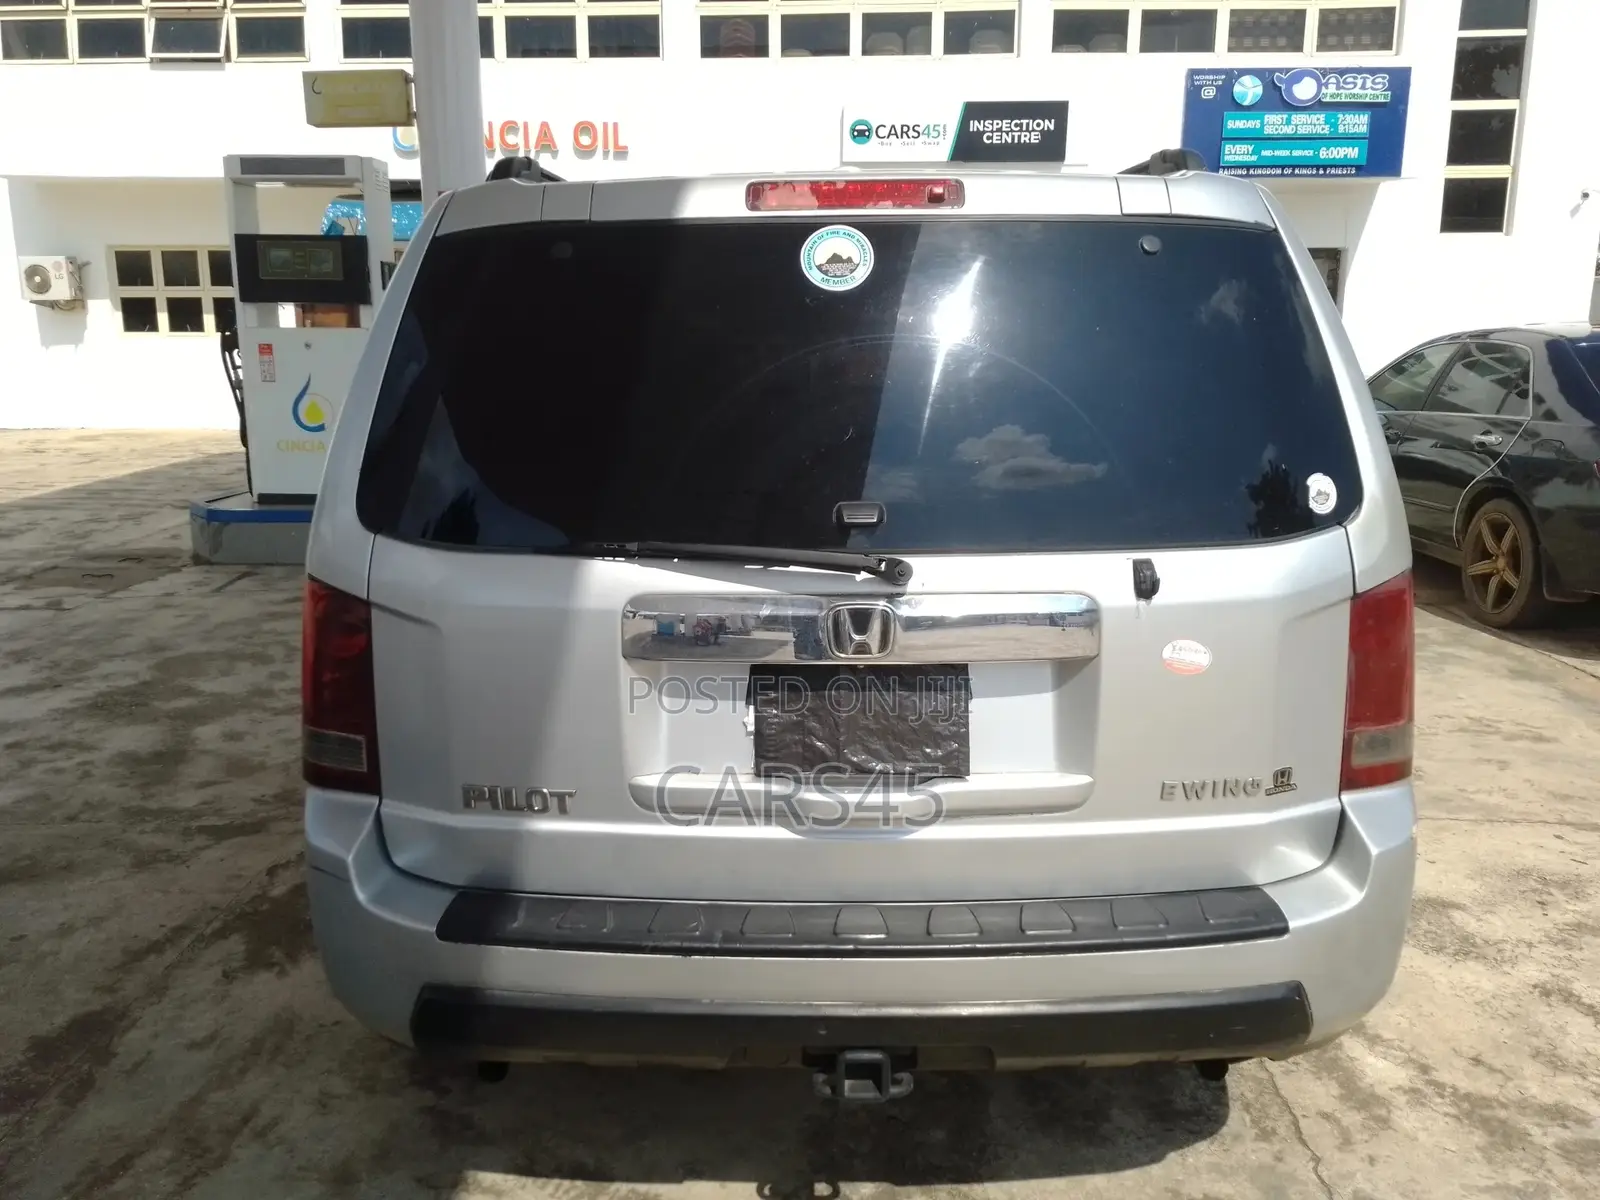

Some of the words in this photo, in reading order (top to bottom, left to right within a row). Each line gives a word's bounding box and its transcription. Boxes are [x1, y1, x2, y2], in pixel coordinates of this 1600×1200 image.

[1274, 68, 1389, 106] OASIS
[1321, 92, 1329, 100] OF
[1329, 92, 1343, 100] HOPE
[1344, 92, 1368, 100] WORSHIP
[1369, 92, 1390, 100] CENTRE
[969, 119, 1055, 132] INSPECTION
[1227, 119, 1261, 129] SUNDAYS
[1264, 114, 1288, 125] FIRST
[1291, 114, 1326, 124] SERVICE
[1337, 114, 1368, 124] 7:30AM
[875, 124, 941, 139] CARS45
[1264, 124, 1296, 134] SECOND
[1297, 124, 1330, 134] SERVICE
[1338, 124, 1367, 133] 9:15AM
[483, 120, 558, 151] NCIA
[573, 120, 629, 152] OIL
[983, 131, 1040, 144] CENTRE
[1224, 144, 1254, 155] EVERY
[1319, 147, 1359, 159] 6:00PM
[806, 240, 818, 271] MOUNTAIN
[842, 230, 856, 240] AND
[820, 275, 856, 286] MEMBER
[276, 439, 327, 453] CINCIA
[1160, 777, 1262, 801] EWING
[1265, 783, 1297, 796] HONDA
[462, 784, 577, 815] PILOT
